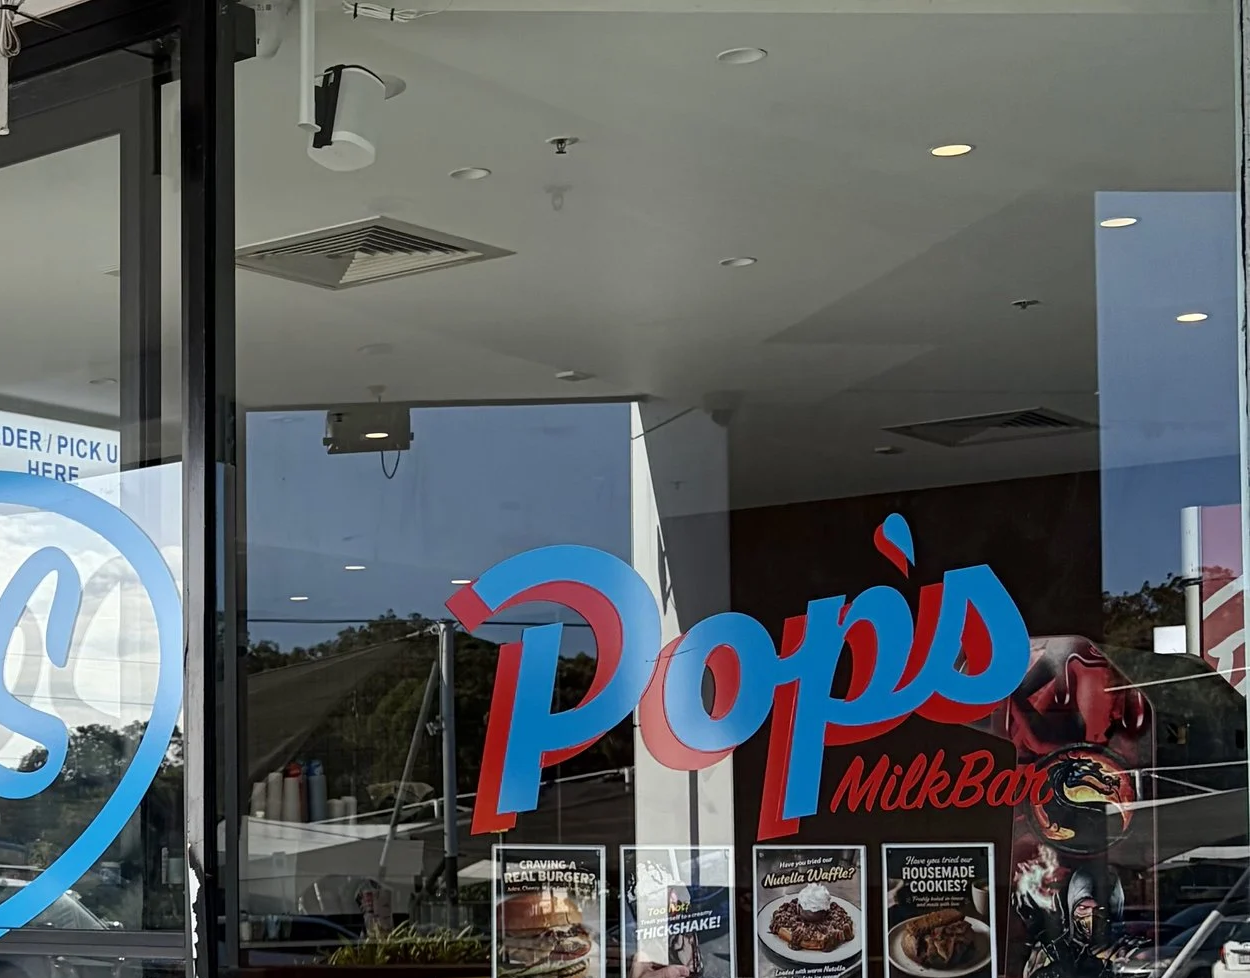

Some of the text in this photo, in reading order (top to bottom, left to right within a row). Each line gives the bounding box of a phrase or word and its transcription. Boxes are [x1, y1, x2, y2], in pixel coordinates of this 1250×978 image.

[57, 434, 102, 462] PICK
[445, 513, 1030, 841] Pop's
[519, 860, 576, 870] CRAVING A
[779, 861, 794, 869] Have
[795, 860, 806, 868] you
[807, 857, 821, 865] tried
[905, 856, 925, 865] Have
[926, 858, 940, 867] you
[941, 855, 960, 864] tried
[504, 870, 596, 885] REAL BURGER?
[763, 866, 855, 887] Nutella Waffle?
[902, 866, 975, 879] HOUSEMADE
[910, 879, 968, 893] COOKIES?
[648, 907, 665, 917] Too
[692, 910, 713, 918] creamy
[636, 915, 721, 940] THICKSHAKE!
[775, 968, 795, 976] Loaded
